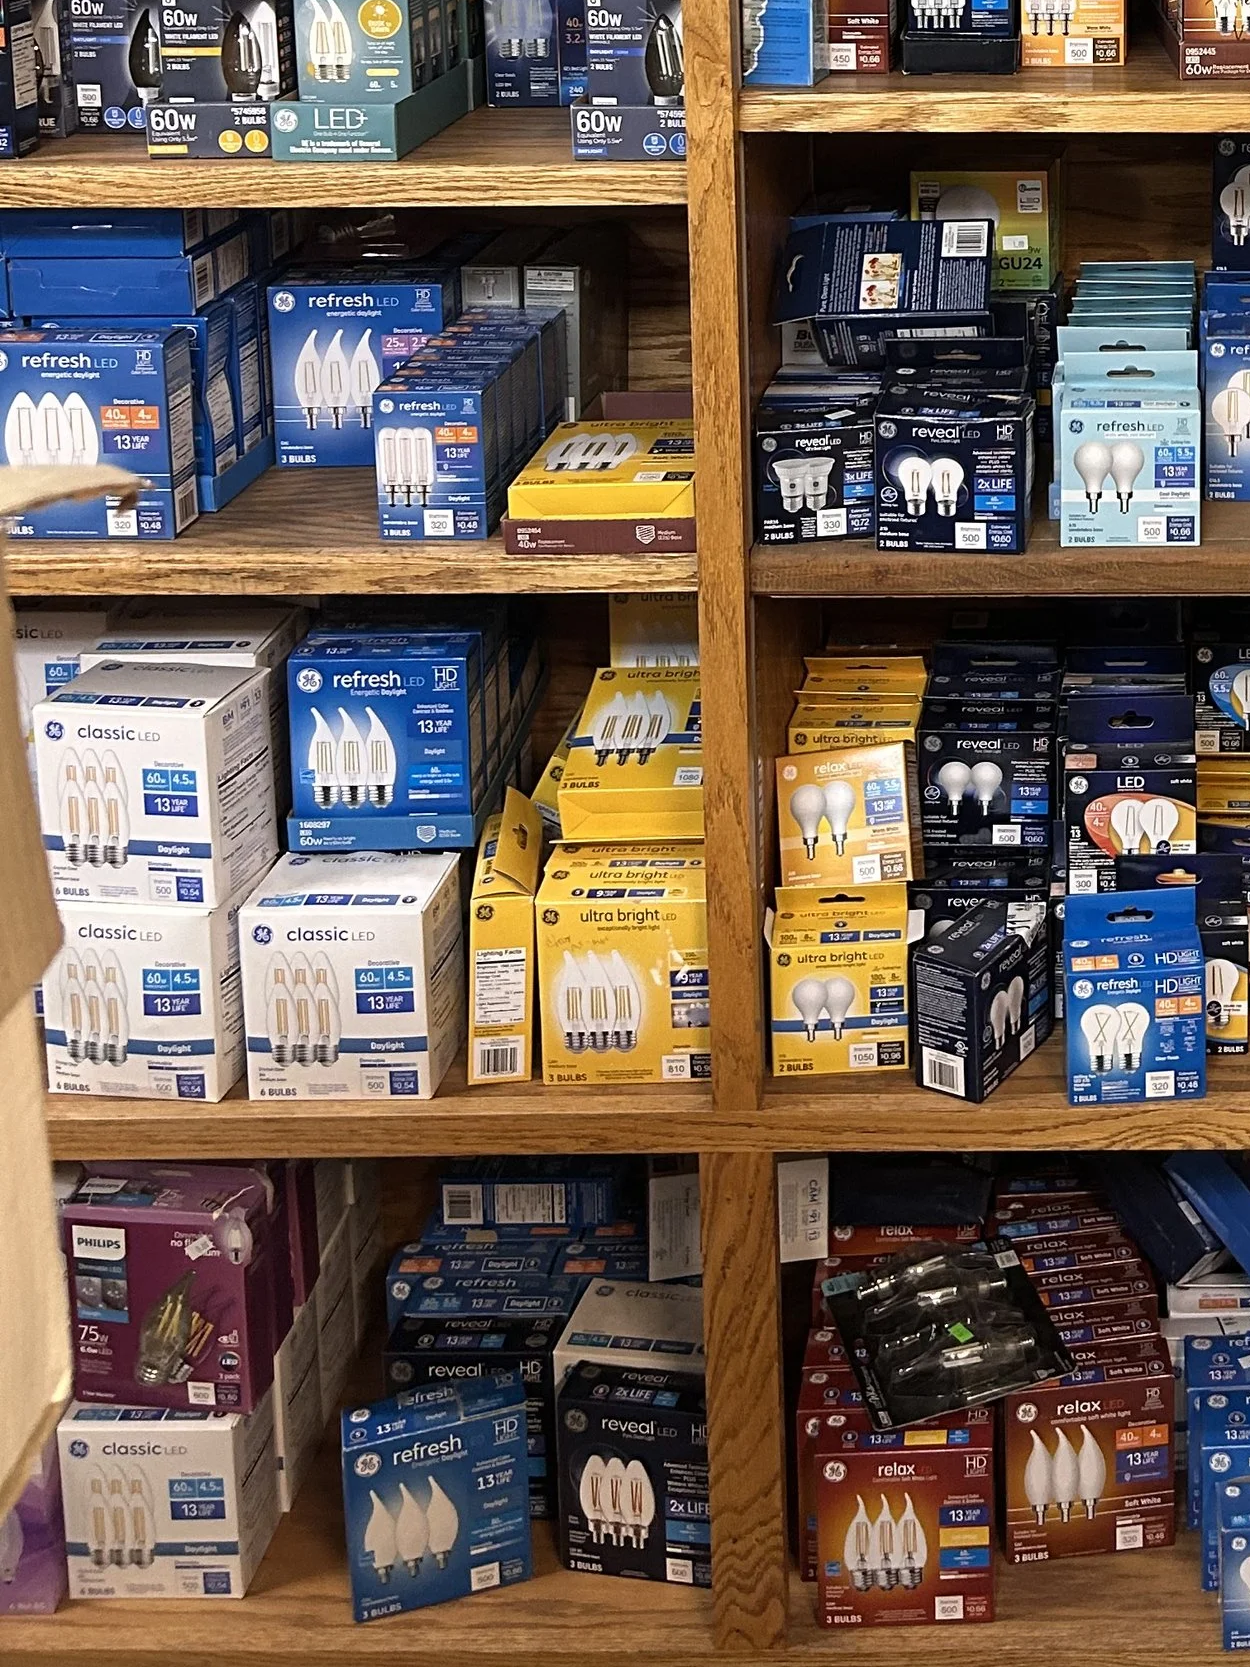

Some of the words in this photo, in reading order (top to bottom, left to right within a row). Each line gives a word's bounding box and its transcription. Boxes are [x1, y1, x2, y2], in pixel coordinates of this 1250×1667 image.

[150, 108, 196, 131] 60w
[235, 116, 240, 125] 2
[242, 115, 266, 125] BULBS
[576, 110, 622, 133] 60w
[1000, 256, 1044, 271] GU24
[308, 293, 374, 307] refresh
[376, 297, 399, 307] LED
[21, 353, 91, 369] refresh
[94, 358, 118, 368] LED
[912, 426, 962, 439] reveal
[962, 430, 980, 439] LED
[1097, 420, 1146, 433] refresh
[1148, 423, 1164, 431] LED
[795, 436, 830, 447] reveal
[282, 455, 287, 463] 3
[289, 455, 316, 463] BULBS
[332, 670, 400, 687] refresh
[404, 675, 425, 687] LED
[77, 725, 136, 741] classic
[138, 731, 160, 742] LED
[813, 734, 840, 745] ultra
[843, 733, 877, 747] bright
[957, 738, 1002, 751] reveal
[1002, 742, 1020, 750] LED
[158, 844, 190, 856] Daylight
[579, 909, 613, 923] ultra
[616, 909, 660, 925] bright
[662, 913, 677, 921] LED
[78, 925, 137, 941] classic
[140, 931, 162, 942] LED
[286, 926, 348, 942] classic
[352, 931, 374, 941] LED
[797, 952, 827, 964] ultra
[830, 952, 868, 965] bright
[1096, 978, 1138, 992] refresh
[370, 1040, 405, 1051] Daylight
[77, 1237, 120, 1250] PHILIPS
[429, 1363, 485, 1378] reveal
[1056, 1400, 1101, 1416] relax
[601, 1417, 657, 1434] reveal
[656, 1427, 677, 1437] LED
[102, 1442, 161, 1456] classic
[165, 1446, 188, 1455] LED
[393, 1436, 462, 1466] refresh
[878, 1462, 915, 1477] relax
